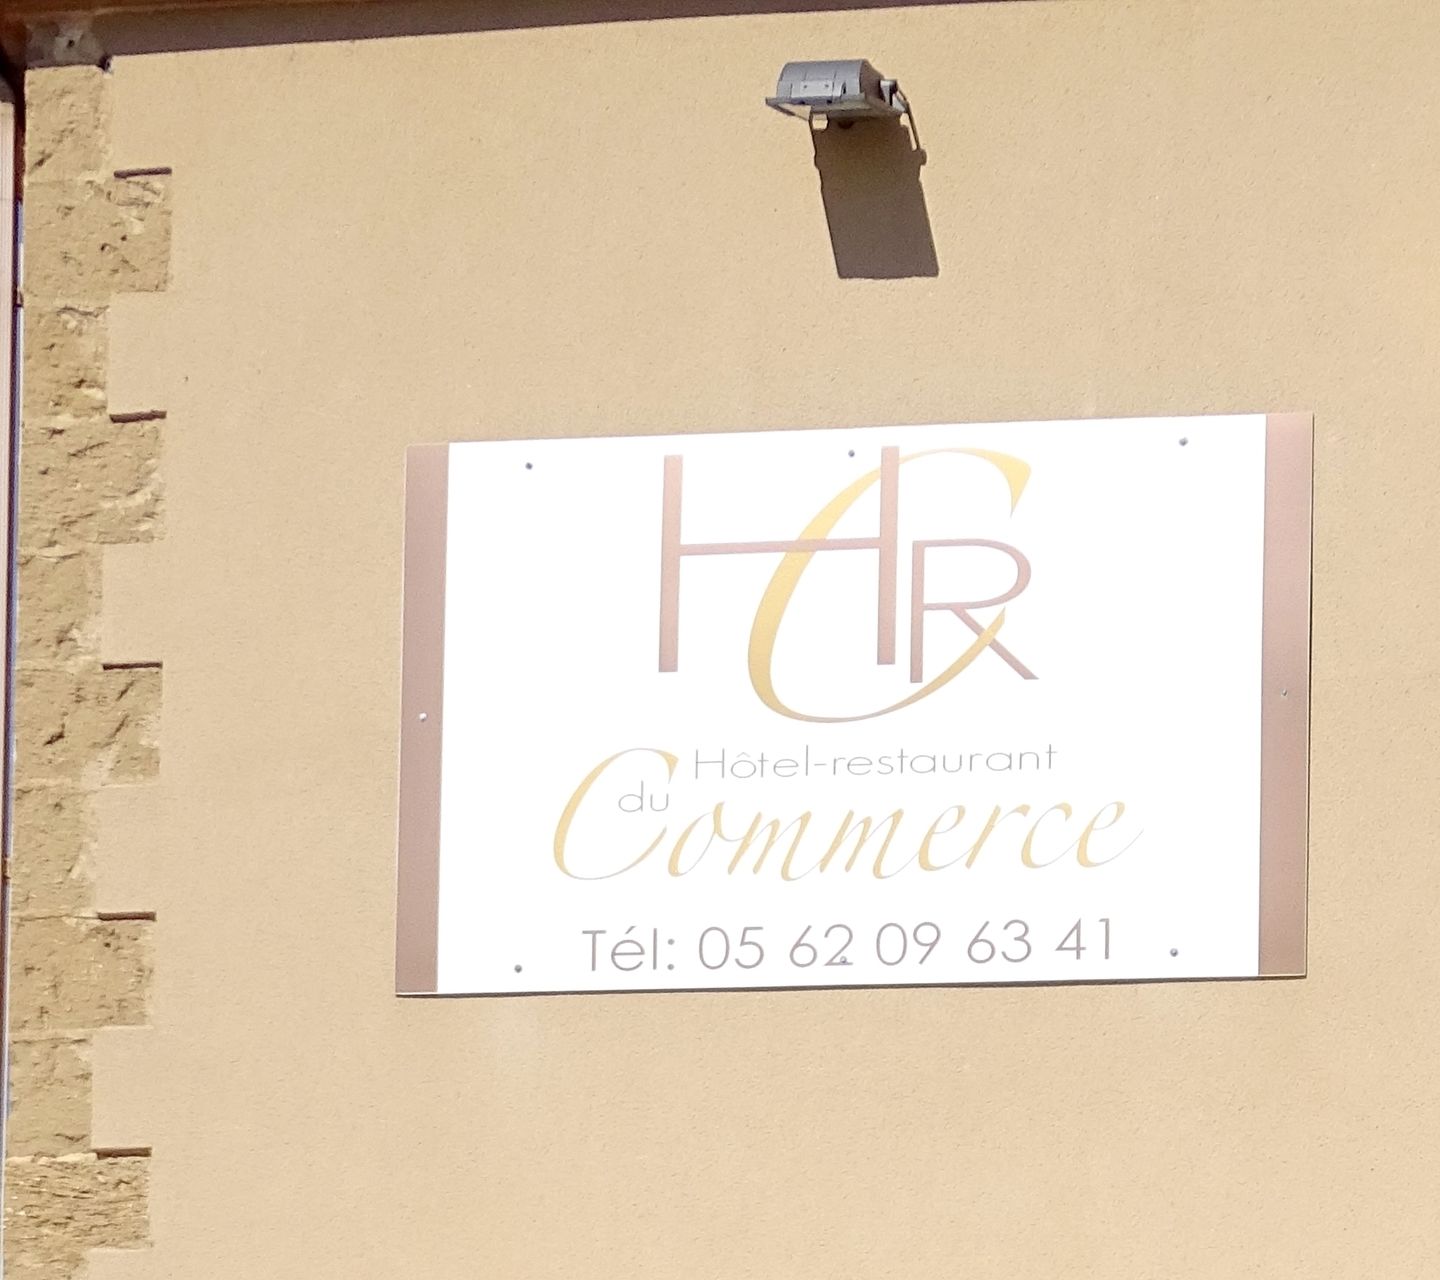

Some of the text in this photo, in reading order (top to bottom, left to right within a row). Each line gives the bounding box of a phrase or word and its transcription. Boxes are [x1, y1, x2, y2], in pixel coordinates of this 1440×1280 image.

[693, 743, 1058, 781] Hôtel-restaurant
[551, 746, 1144, 882] Commerce
[617, 780, 670, 813] du
[581, 917, 1114, 972] Tél: 05 62 09 63 41
